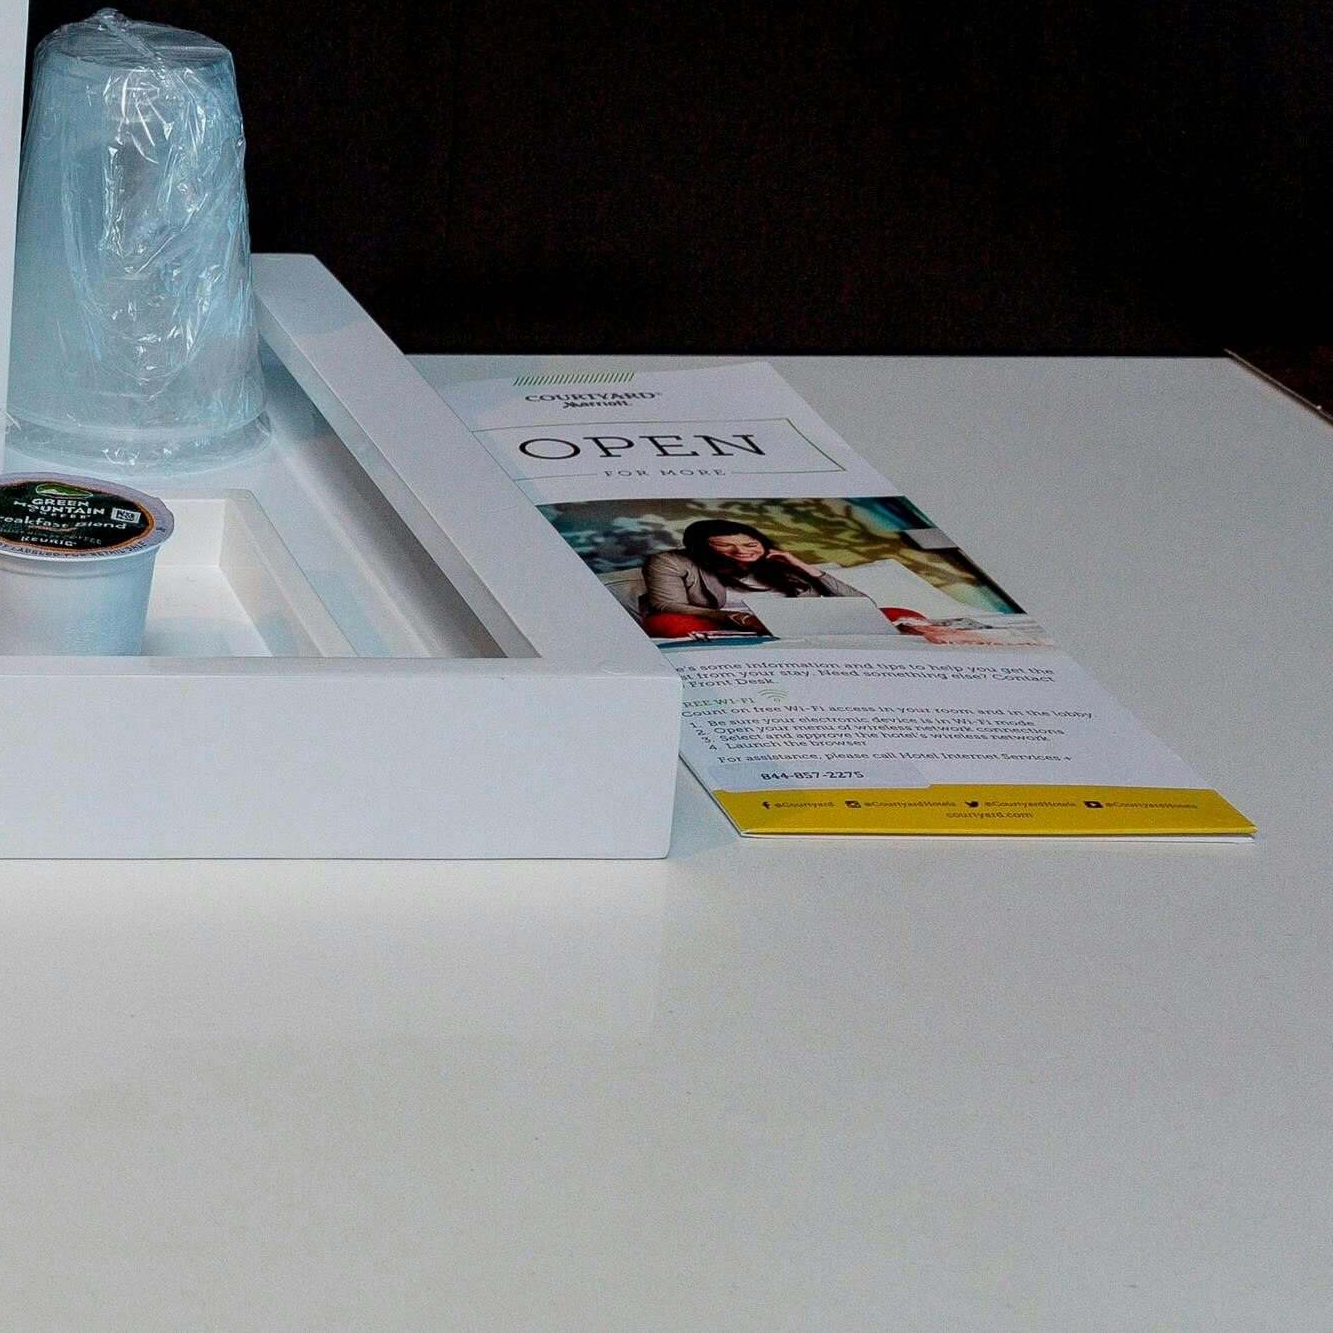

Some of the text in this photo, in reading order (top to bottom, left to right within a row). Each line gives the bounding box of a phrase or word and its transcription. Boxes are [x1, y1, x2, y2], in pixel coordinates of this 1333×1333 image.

[524, 392, 658, 403] COURTYARD
[519, 434, 766, 460] OPEN
[13, 500, 105, 515] MOUNTAIN
[32, 498, 90, 507] GREEN
[74, 520, 127, 530] Blend
[21, 535, 77, 547] KEURIG
[878, 663, 907, 671] tips
[928, 665, 964, 673] help
[1000, 667, 1024, 675] get
[1028, 667, 1054, 675] the
[698, 671, 735, 679] from
[739, 670, 776, 679] your
[863, 671, 947, 680] something
[951, 672, 987, 680] else?
[992, 674, 1056, 682] Contact
[688, 678, 732, 688] Front
[682, 697, 756, 708] REE WI-FI
[681, 707, 727, 718] Count
[897, 707, 930, 715] your
[935, 707, 974, 715] room
[977, 708, 1004, 716] and
[707, 719, 726, 727] Be
[763, 717, 795, 725] your
[954, 718, 992, 726] Wi-Fi
[714, 727, 753, 735] Open
[756, 724, 789, 733] your
[915, 725, 973, 733] network
[976, 726, 1066, 735] connections
[719, 733, 763, 742] Select
[766, 732, 794, 740] and
[797, 731, 852, 740] approve
[854, 731, 879, 739] the
[881, 731, 929, 740] hotel's
[931, 732, 987, 741] wireless
[991, 733, 1050, 742] network
[726, 741, 782, 750] Launch
[783, 740, 806, 748] the
[808, 739, 867, 748] browser
[717, 755, 742, 764] For
[746, 752, 822, 762] assistance,
[825, 752, 870, 761] please
[898, 752, 940, 760] Hotel
[941, 752, 998, 761] Internet
[1001, 752, 1061, 762] Services
[760, 770, 865, 781] 844-857-2275
[863, 800, 956, 809] @CourtyardHotels
[984, 800, 1077, 809] @CourtyardHotels
[945, 810, 1034, 819] courtyard.com
